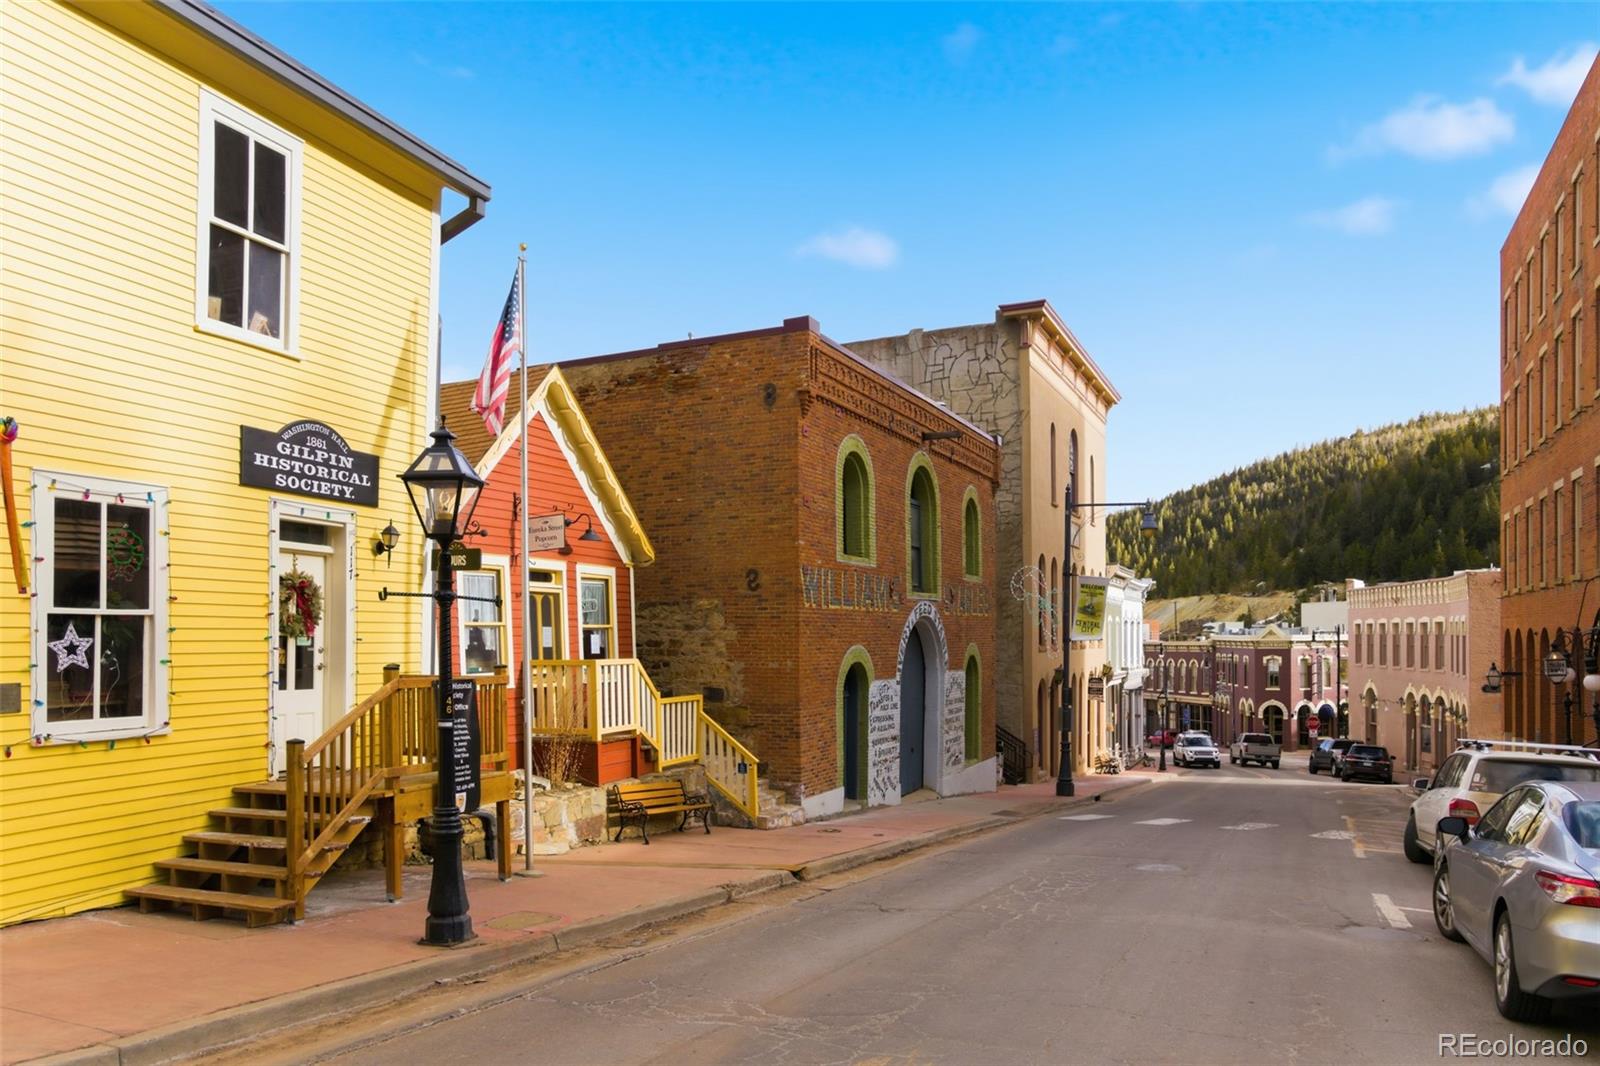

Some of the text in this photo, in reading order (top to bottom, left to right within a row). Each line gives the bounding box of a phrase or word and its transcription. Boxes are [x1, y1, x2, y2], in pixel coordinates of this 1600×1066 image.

[281, 423, 349, 455] WASHINGTON HALL
[305, 436, 327, 450] 1861
[276, 441, 354, 469] GILPIN
[253, 452, 371, 487] HISTORICAL
[275, 473, 356, 499] SOCIETY.
[534, 535, 558, 543] Popcorn
[1080, 583, 1106, 591] WELCOME
[914, 602, 933, 619] FEED
[1075, 619, 1100, 628] CENTRAL
